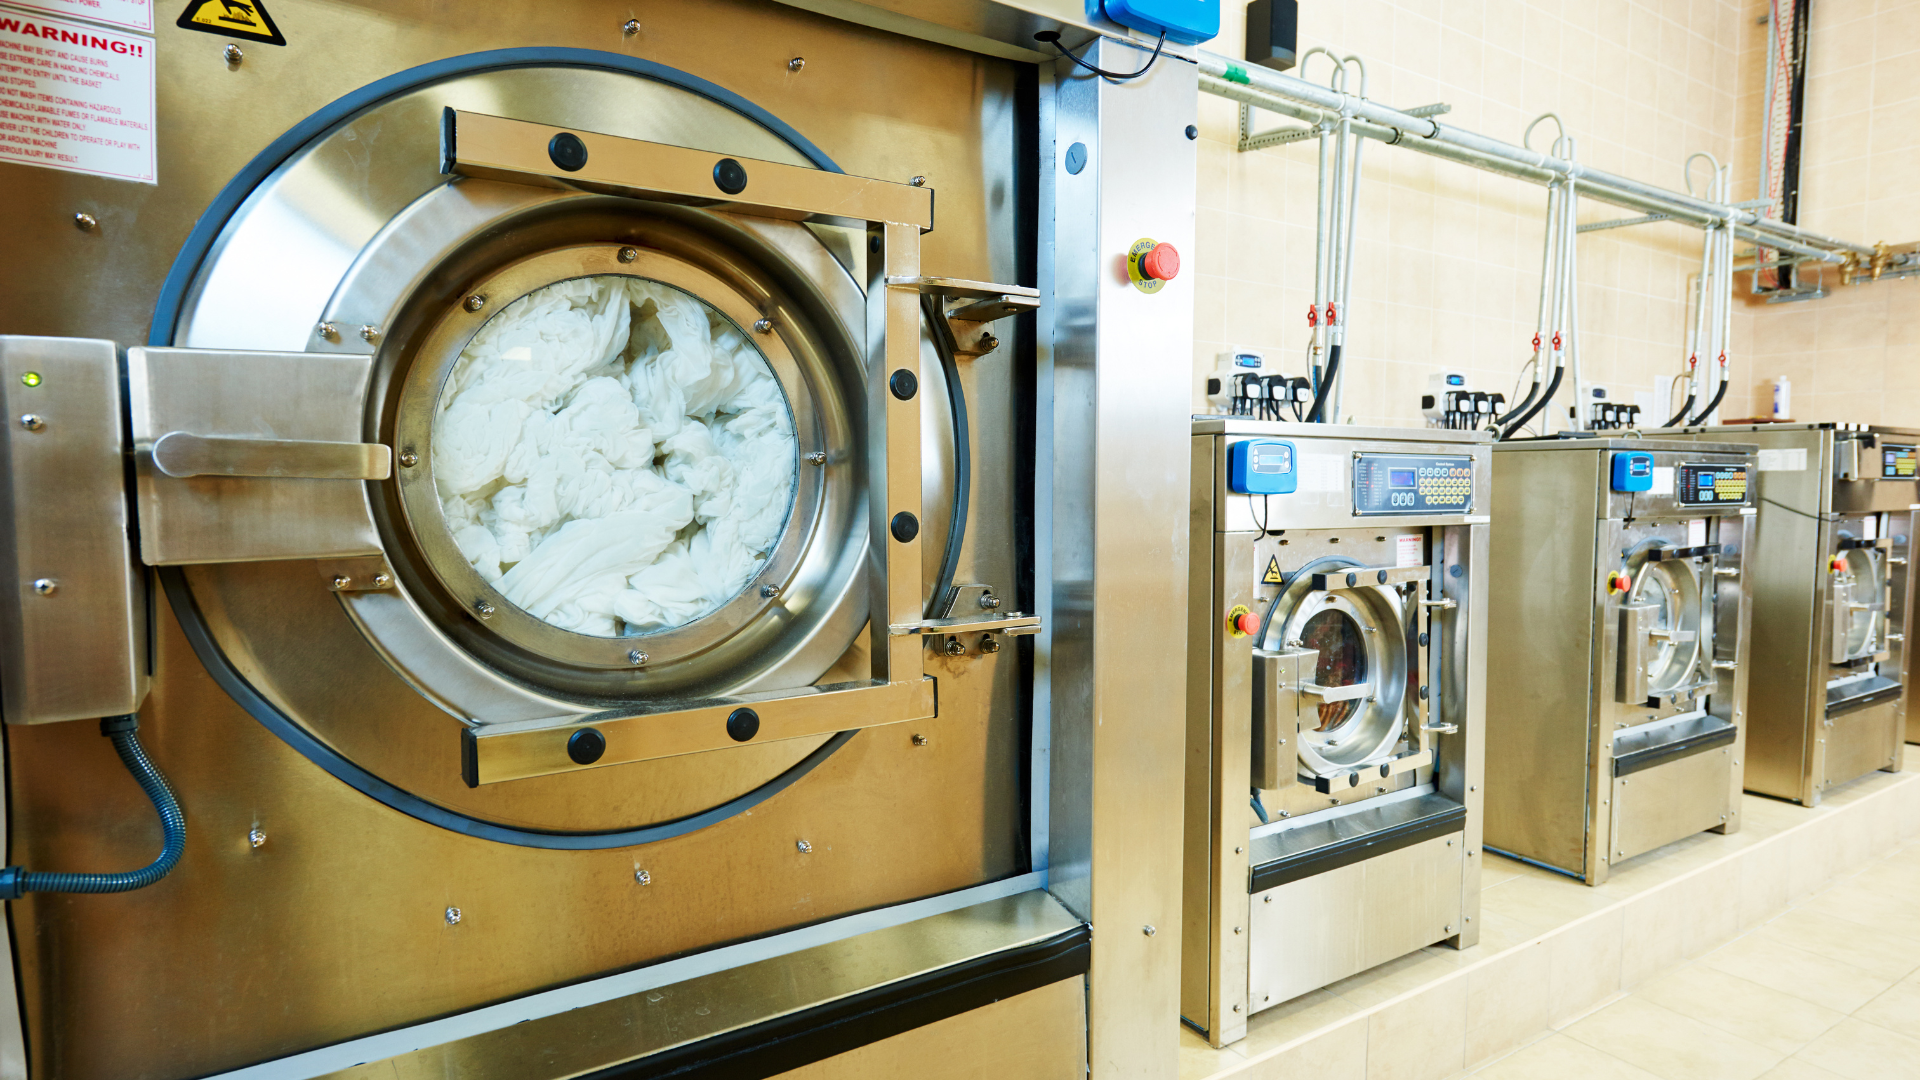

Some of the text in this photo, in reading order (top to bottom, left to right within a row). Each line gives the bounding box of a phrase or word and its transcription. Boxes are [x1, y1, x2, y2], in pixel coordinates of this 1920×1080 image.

[0, 17, 143, 58] WARNING!!
[9, 53, 35, 65] EXTREME
[36, 59, 52, 68] CARE
[60, 64, 88, 75] HANDLING
[89, 69, 120, 81] CHEMICALS.
[23, 45, 34, 53] MAY
[36, 47, 43, 55] BE
[45, 49, 56, 57] HOT
[57, 52, 69, 60] AND
[70, 53, 88, 64] CAUSE
[90, 57, 108, 68] BURNS.
[0, 75, 8, 84] AS
[23, 68, 31, 76] NO
[33, 69, 50, 79] ENTRY
[52, 73, 68, 82] UNTIL
[69, 76, 79, 85] THE
[81, 78, 102, 88] BASKET
[7, 88, 18, 96] NOT
[20, 90, 36, 99] WASH
[38, 93, 53, 103] ITEMS
[55, 96, 88, 109] CONTAINING
[89, 103, 121, 115] HAZARDOUS
[10, 112, 35, 123] MACHINE
[37, 116, 50, 125] WITH
[52, 119, 70, 128] WATER
[62, 108, 80, 119] FUMES
[90, 114, 118, 125] FLAMABLE
[119, 119, 148, 130] MATERIALS.
[8, 134, 31, 145] AROUND
[33, 139, 57, 149] MACHINE
[30, 126, 40, 135] THE
[42, 128, 69, 140] CHILDREN
[71, 133, 78, 141] TO
[79, 134, 103, 146] OPERATE
[114, 140, 126, 148] PLAY
[128, 143, 140, 151] WITH
[24, 149, 43, 158] INJURY
[45, 151, 56, 160] MAY
[1130, 242, 1156, 263] EMERGE
[1139, 279, 1157, 288] STOP
